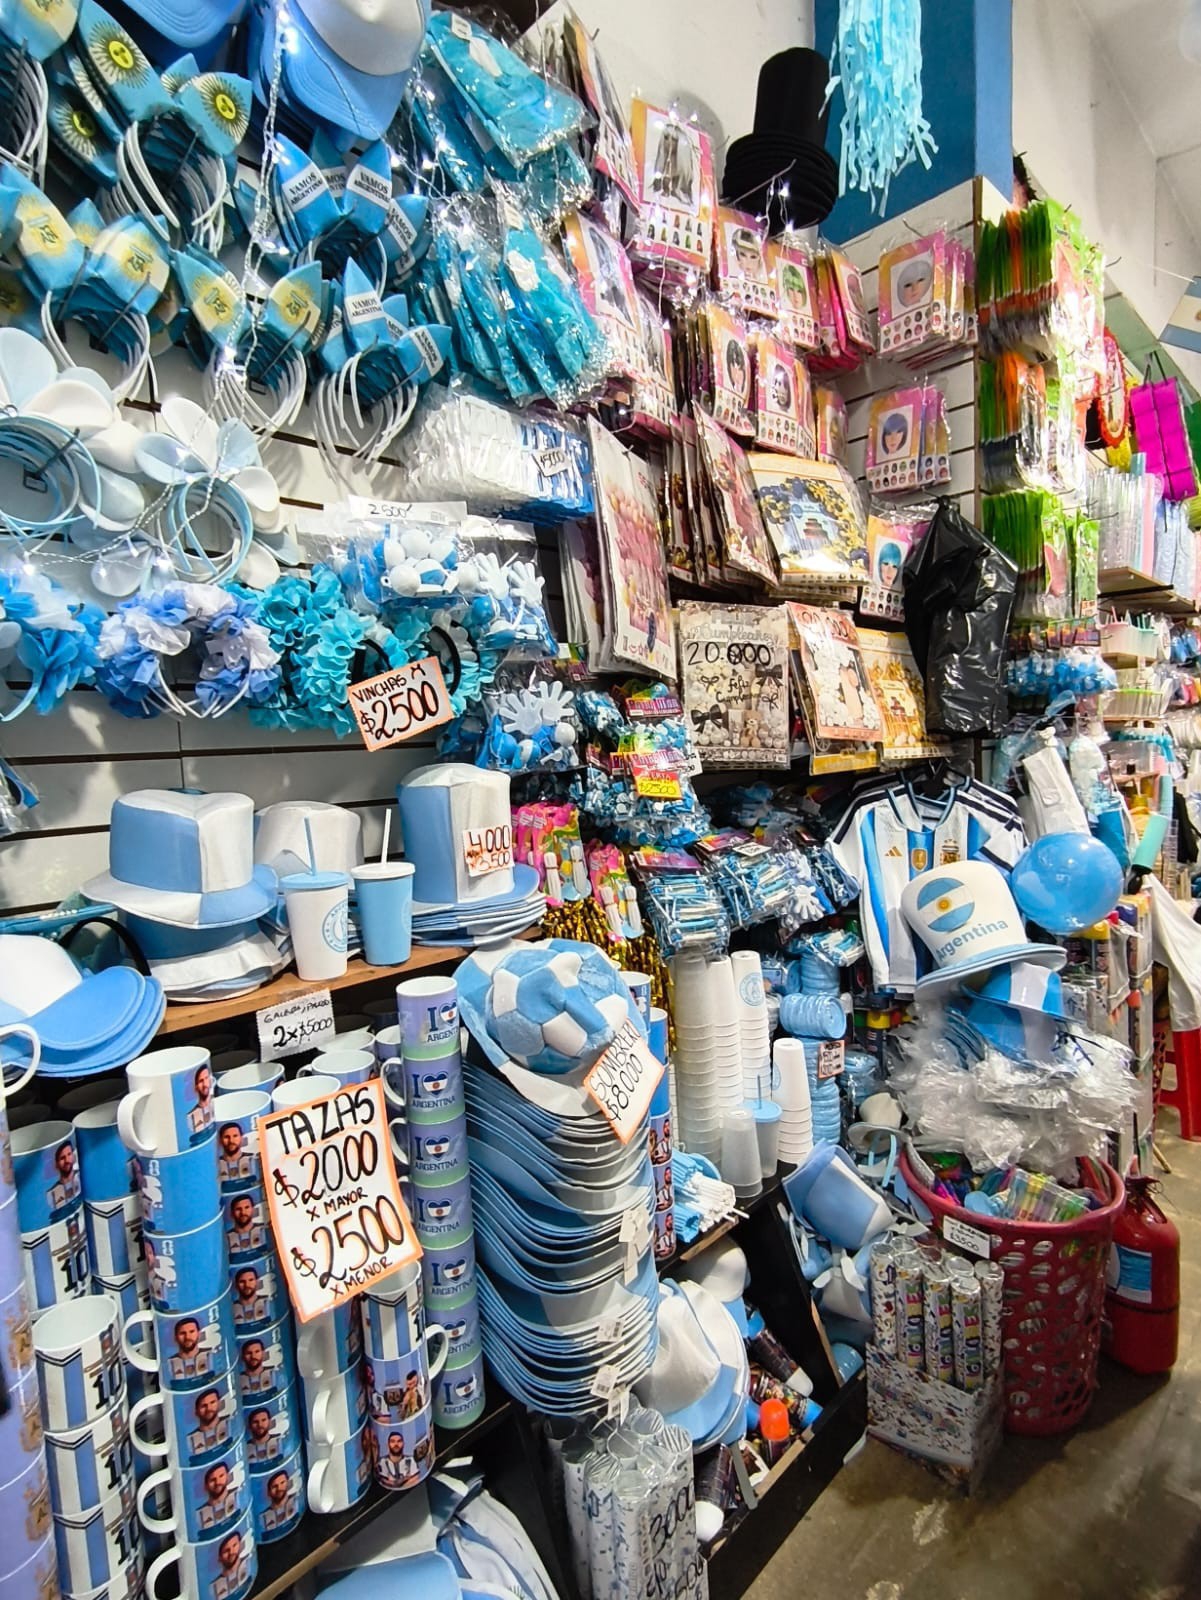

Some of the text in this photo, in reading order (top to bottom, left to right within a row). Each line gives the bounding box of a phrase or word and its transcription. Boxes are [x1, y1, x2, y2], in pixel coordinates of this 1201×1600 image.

[289, 172, 317, 195] VAMOS
[360, 172, 388, 194] VAMOS
[352, 298, 377, 309] VAMOS
[352, 674, 407, 703] VINCHAS
[360, 681, 439, 740] $2500
[469, 825, 511, 853] 4000
[935, 920, 1009, 961] Argentina
[412, 1073, 421, 1099] I
[412, 1095, 456, 1109] ARGENTINA
[265, 1086, 375, 1155] TAZAS
[414, 1136, 424, 1161] I
[273, 1130, 378, 1208] $2000
[415, 1157, 459, 1171] ARGENTINA
[323, 1187, 368, 1216] MAYOR
[417, 1198, 426, 1222] I
[418, 1221, 461, 1234] ARGENTINA
[290, 1195, 404, 1289] $2500
[343, 1256, 393, 1293] MENOR
[431, 1262, 441, 1287] I
[92, 1357, 123, 1409] 10
